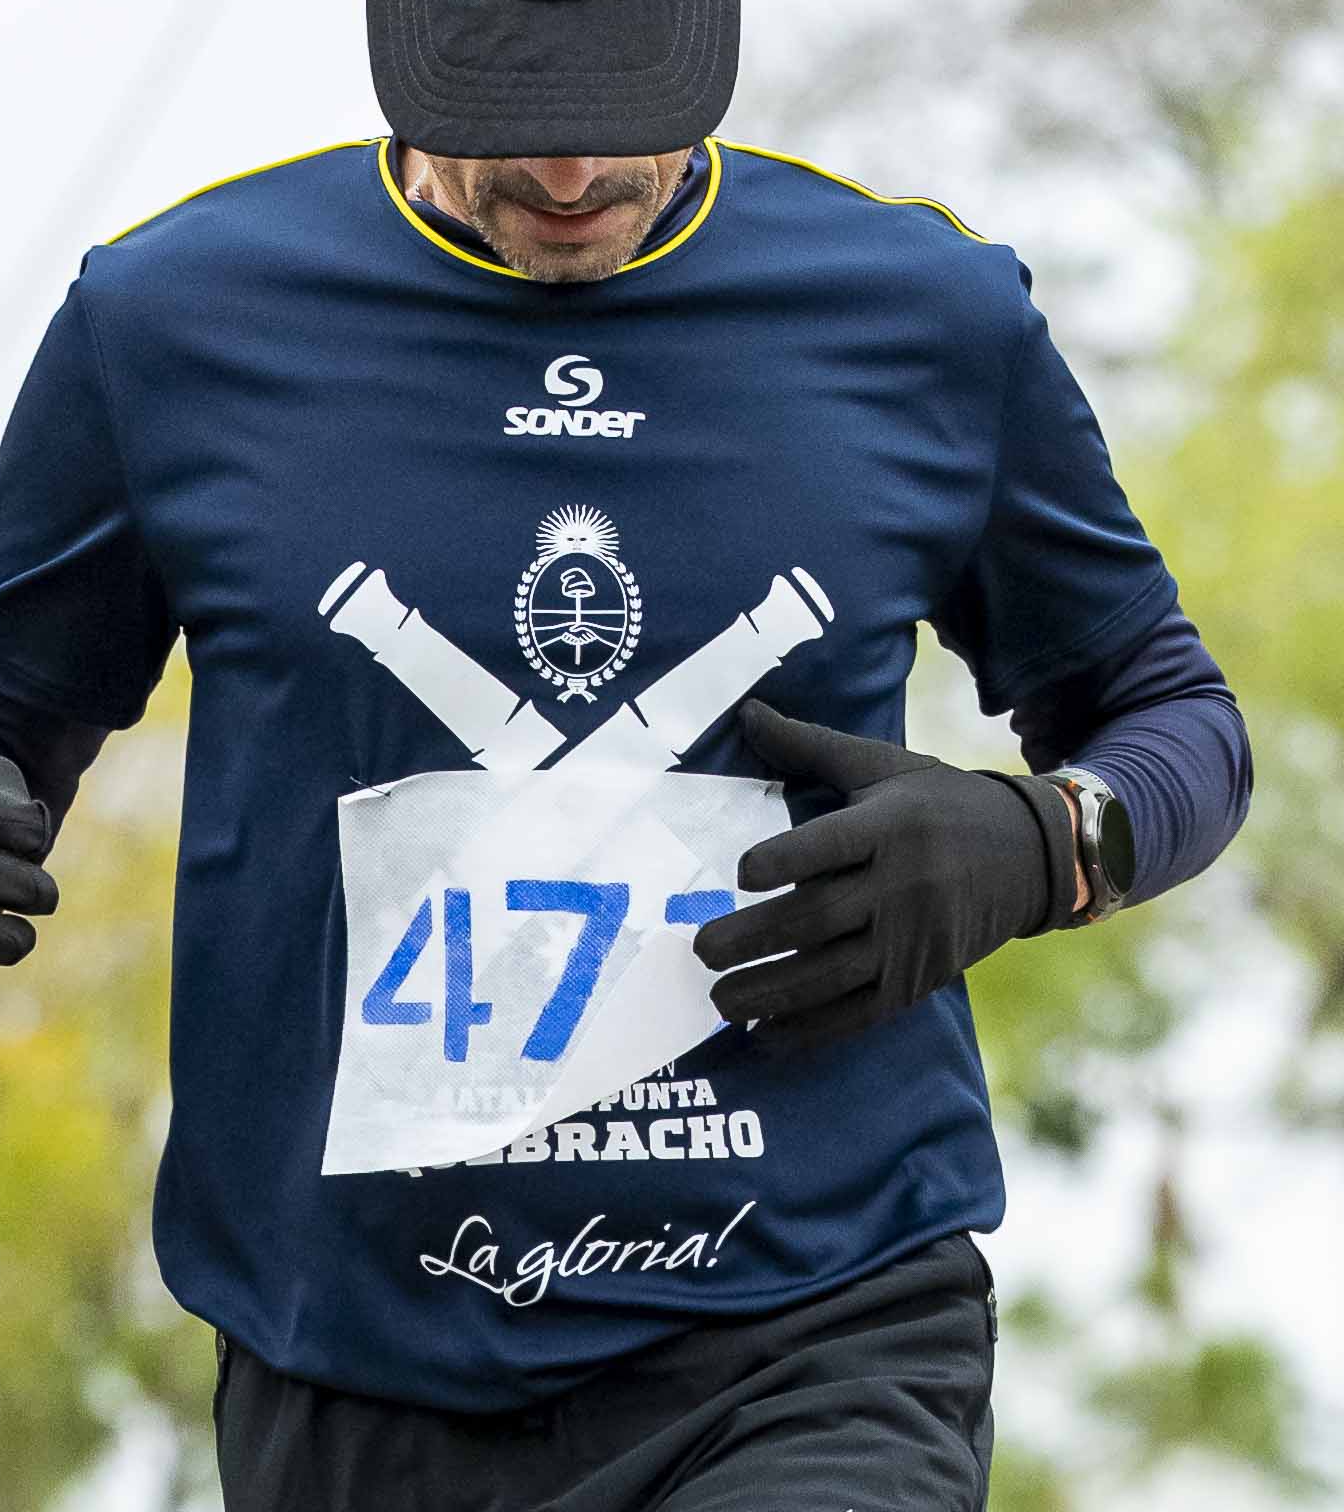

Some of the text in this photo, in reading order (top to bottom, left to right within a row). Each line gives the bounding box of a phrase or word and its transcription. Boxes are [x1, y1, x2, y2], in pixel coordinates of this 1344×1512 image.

[395, 1110, 764, 1178] BRACHO
[420, 1201, 756, 1307] La gloria!
